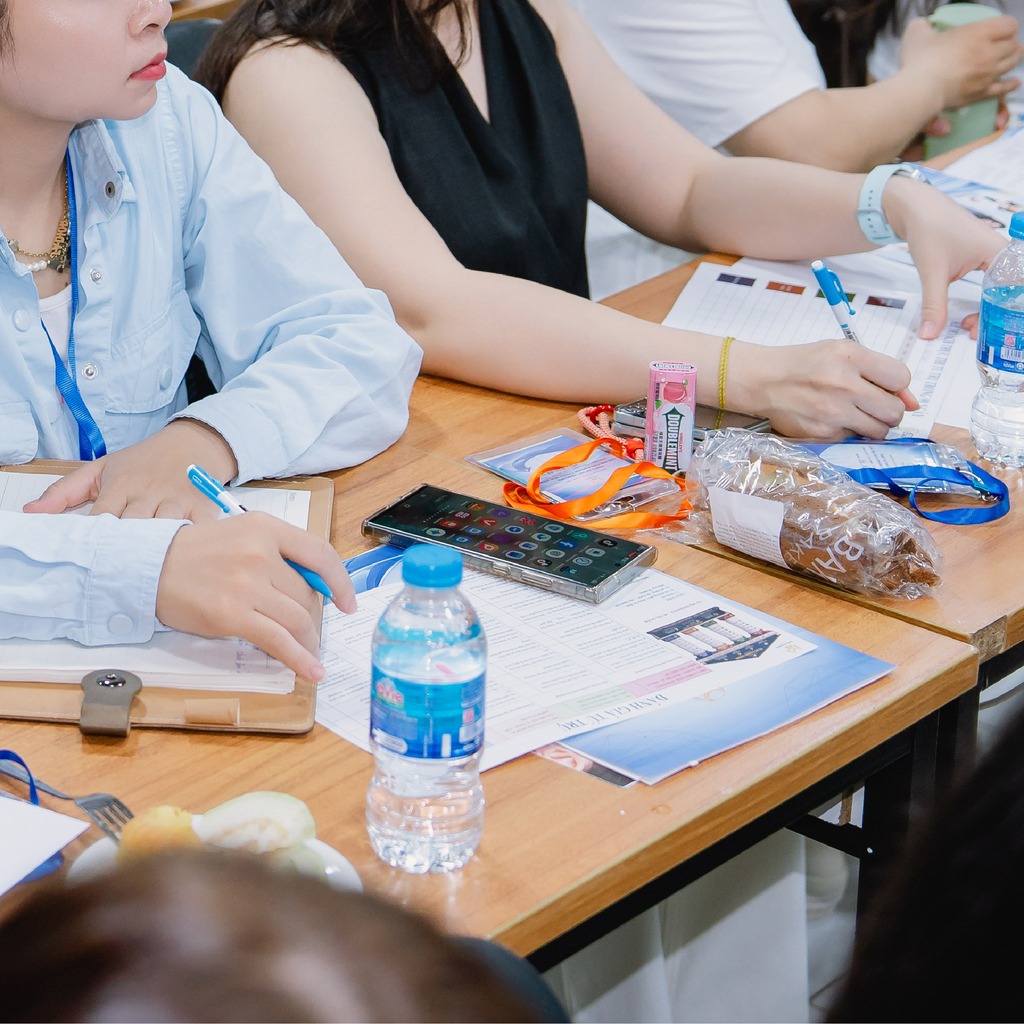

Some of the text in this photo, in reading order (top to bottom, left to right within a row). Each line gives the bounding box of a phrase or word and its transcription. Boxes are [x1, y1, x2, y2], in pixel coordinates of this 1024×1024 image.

[665, 414, 680, 471] DOUBLEMINT
[604, 704, 634, 718] GIÁ
[628, 693, 672, 711] ĐÁNH
